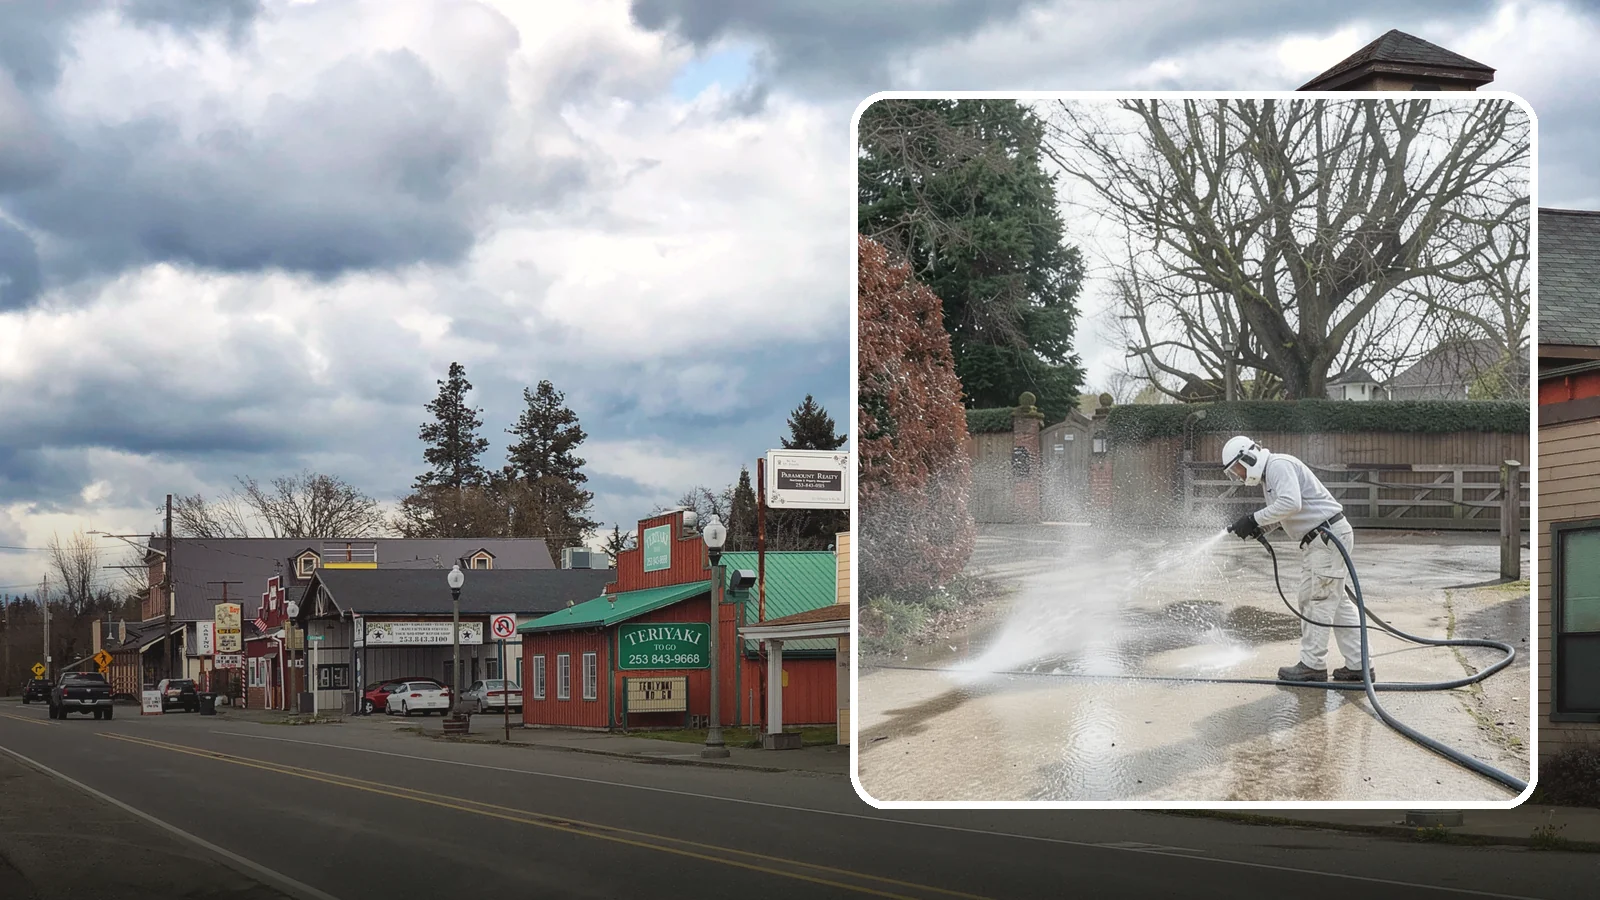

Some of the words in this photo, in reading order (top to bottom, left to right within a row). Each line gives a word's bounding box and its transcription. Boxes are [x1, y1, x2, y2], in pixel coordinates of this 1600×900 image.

[625, 627, 702, 646] TERIYAKI
[629, 655, 649, 665] 253
[651, 654, 700, 664] 843-9668
